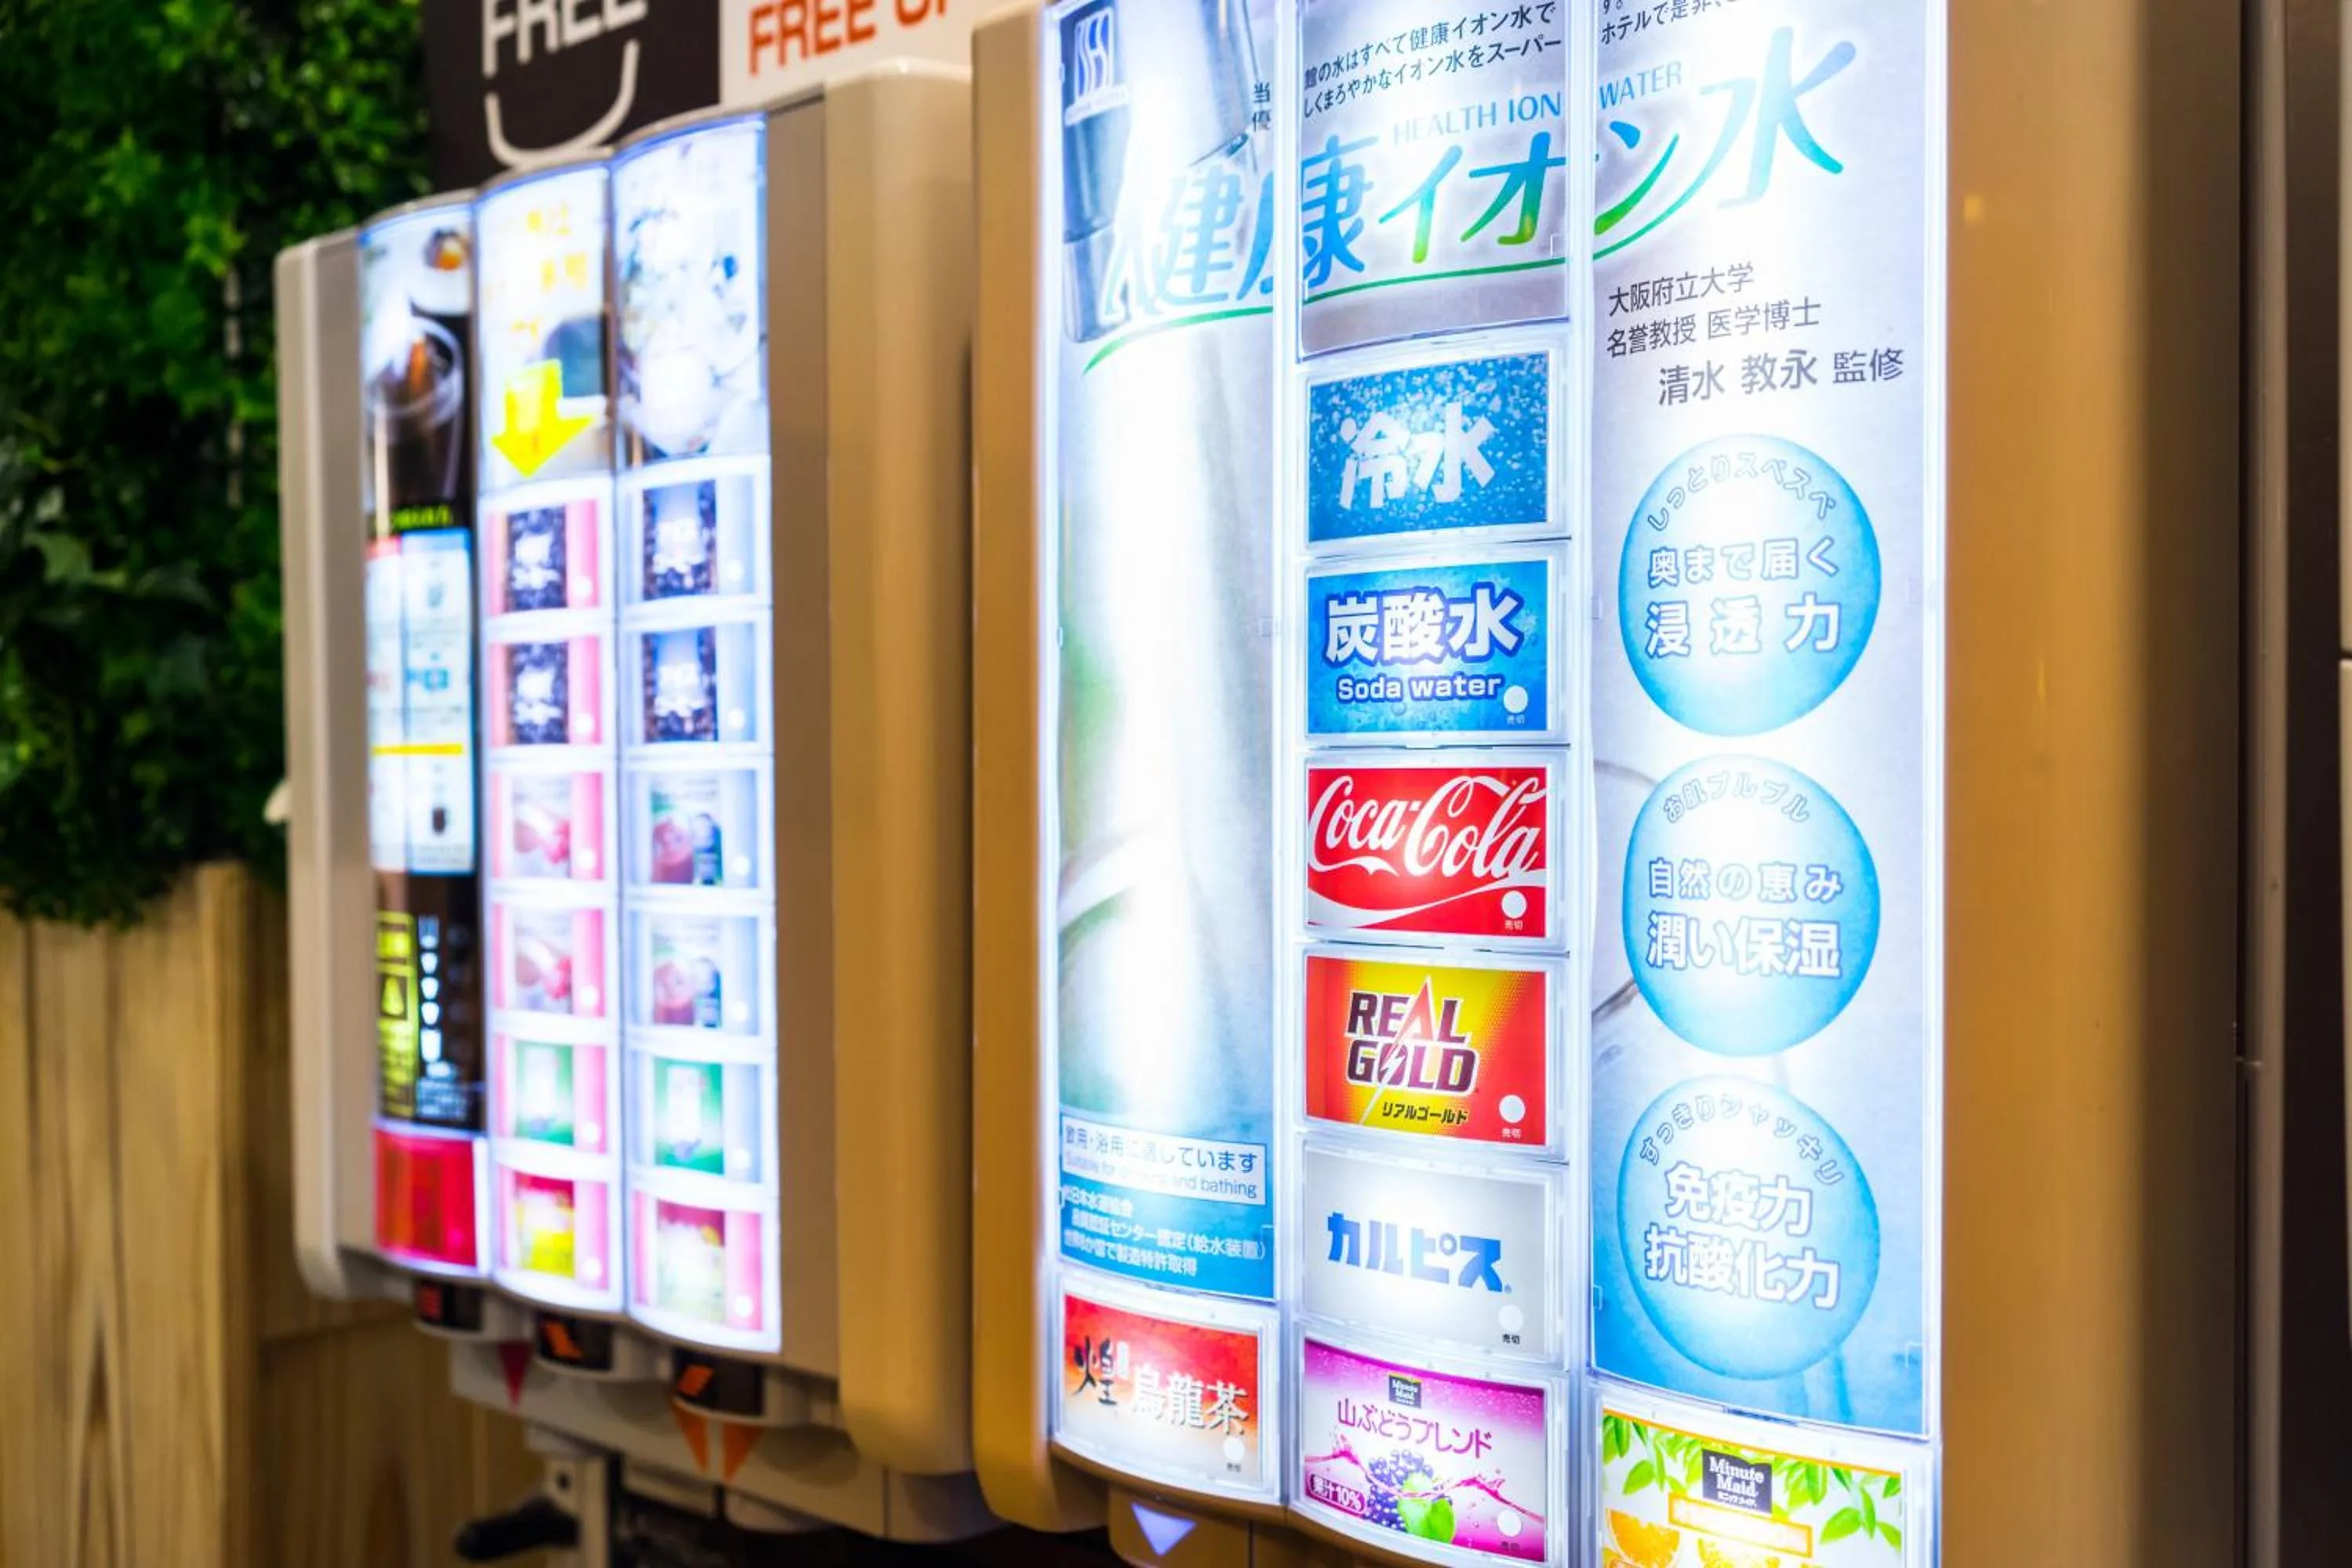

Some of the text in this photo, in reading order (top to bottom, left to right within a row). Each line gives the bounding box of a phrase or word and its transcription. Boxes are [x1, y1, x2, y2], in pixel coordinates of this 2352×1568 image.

[750, 0, 876, 75] FREE
[1393, 60, 1682, 145] HEALTH ION WATER
[1608, 261, 1755, 317] 大阪府立大学
[1606, 296, 1821, 358] 名誉教授 医学博士
[1658, 347, 1905, 406] 清水 教永 監修
[1339, 401, 1499, 510] 冷水
[1647, 535, 1840, 589] 奥まで届く
[1323, 584, 1523, 666] 炭酸水
[1645, 592, 1842, 659] 浸透力
[1338, 675, 1502, 701] Soda water
[1308, 775, 1547, 878] Coca-Cola
[1648, 857, 1844, 903] 自然の恵み
[1646, 909, 1843, 979] 潤い保湿
[1345, 975, 1472, 1046] REAL
[1345, 1037, 1479, 1095] GOLD
[1381, 1101, 1468, 1125] リアルゴールド
[1200, 1176, 1258, 1200] bathing
[1664, 1160, 1814, 1238] 免疫力
[1327, 1211, 1504, 1294] カルピス
[1645, 1222, 1841, 1311] 抗酸化力
[1338, 1398, 1493, 1459] 山ぶどうブレンド
[1708, 1456, 1764, 1483] Minute
[1716, 1474, 1757, 1498] Maid
